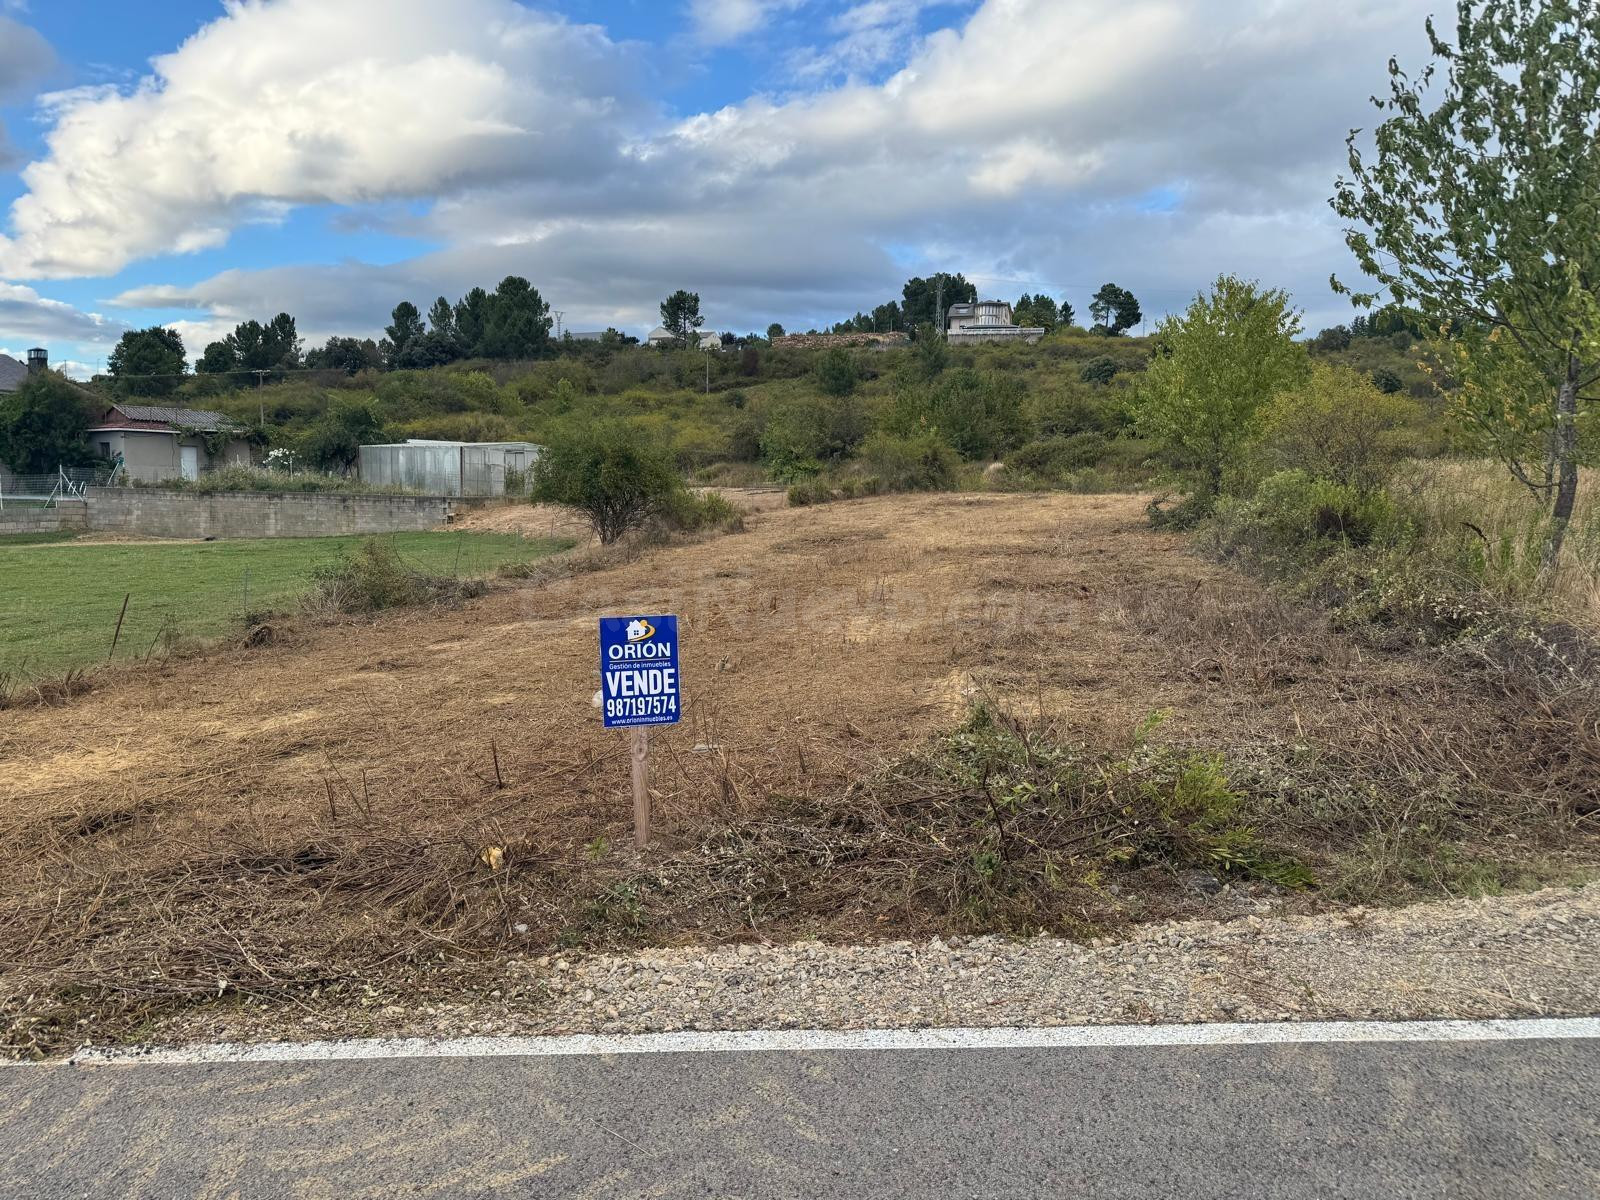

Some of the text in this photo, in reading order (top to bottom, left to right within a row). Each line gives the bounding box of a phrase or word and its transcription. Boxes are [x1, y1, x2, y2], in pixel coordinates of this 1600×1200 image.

[608, 641, 671, 659] ORIÓN
[606, 668, 676, 697] VENDE
[607, 695, 676, 717] 987197574
